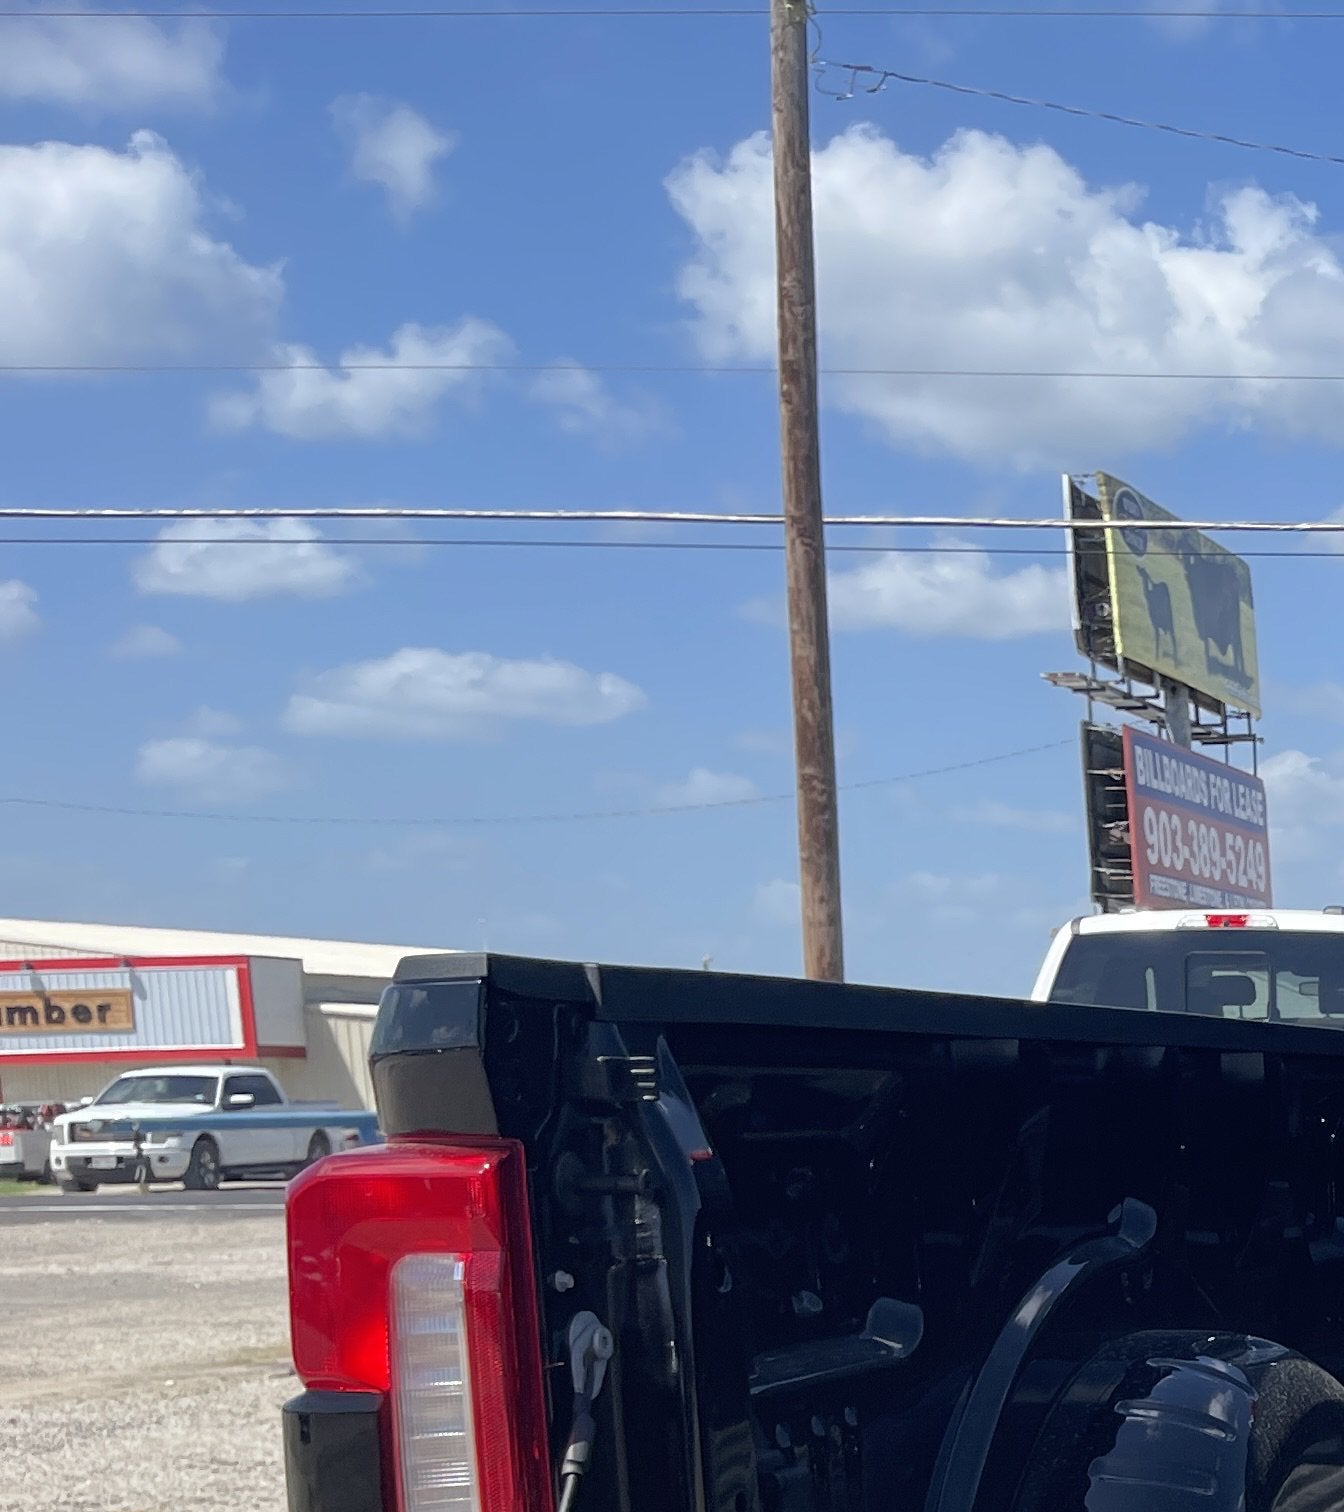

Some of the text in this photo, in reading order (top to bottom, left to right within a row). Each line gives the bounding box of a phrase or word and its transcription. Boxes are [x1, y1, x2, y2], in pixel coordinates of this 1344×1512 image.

[1133, 744, 1264, 827] BILLBOARDS FOR LEASE
[1143, 806, 1265, 893] 903-389-5249
[0, 996, 112, 1026] mber
